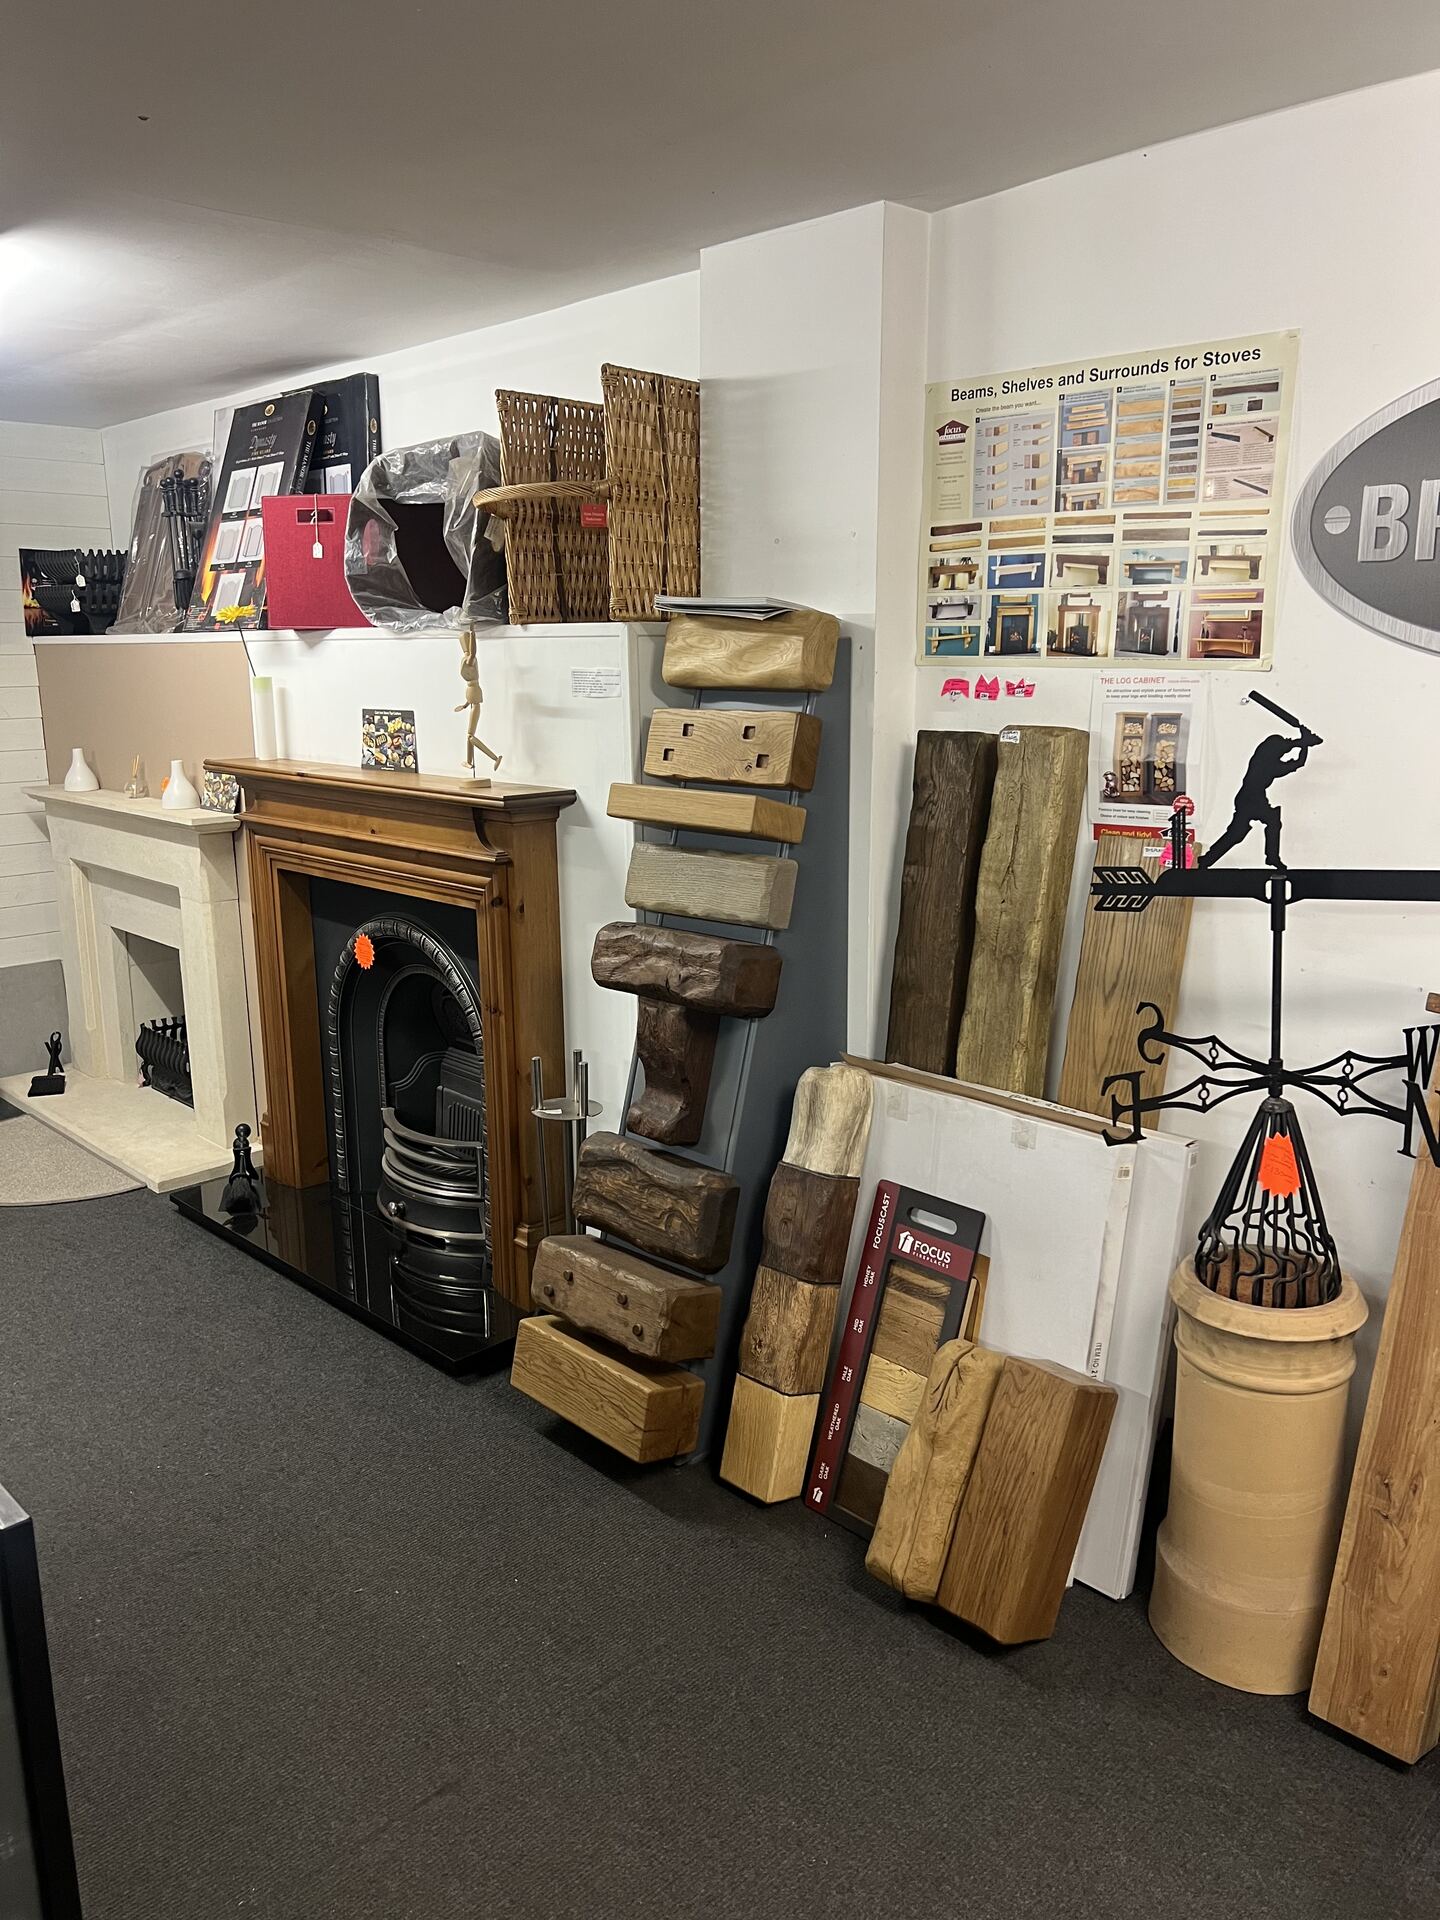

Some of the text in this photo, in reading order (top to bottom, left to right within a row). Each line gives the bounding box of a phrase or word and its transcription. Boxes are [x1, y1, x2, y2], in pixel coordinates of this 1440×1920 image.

[951, 348, 1262, 402] Beams, Shelves and Surrounds for Stoves
[1100, 677, 1114, 685] THE
[1116, 677, 1133, 685] LOG
[1135, 676, 1165, 684] CABINET
[872, 1192, 891, 1250] FOCUSCAST
[912, 1251, 949, 1269] FIREPLACES
[913, 1240, 952, 1264] FOCUS
[863, 1265, 872, 1287] HONEY
[857, 1320, 865, 1334] OAK
[841, 1365, 849, 1381] PALE
[827, 1403, 840, 1440] WEATHERED
[834, 1417, 842, 1431] OAK
[818, 1462, 826, 1480] DARK
